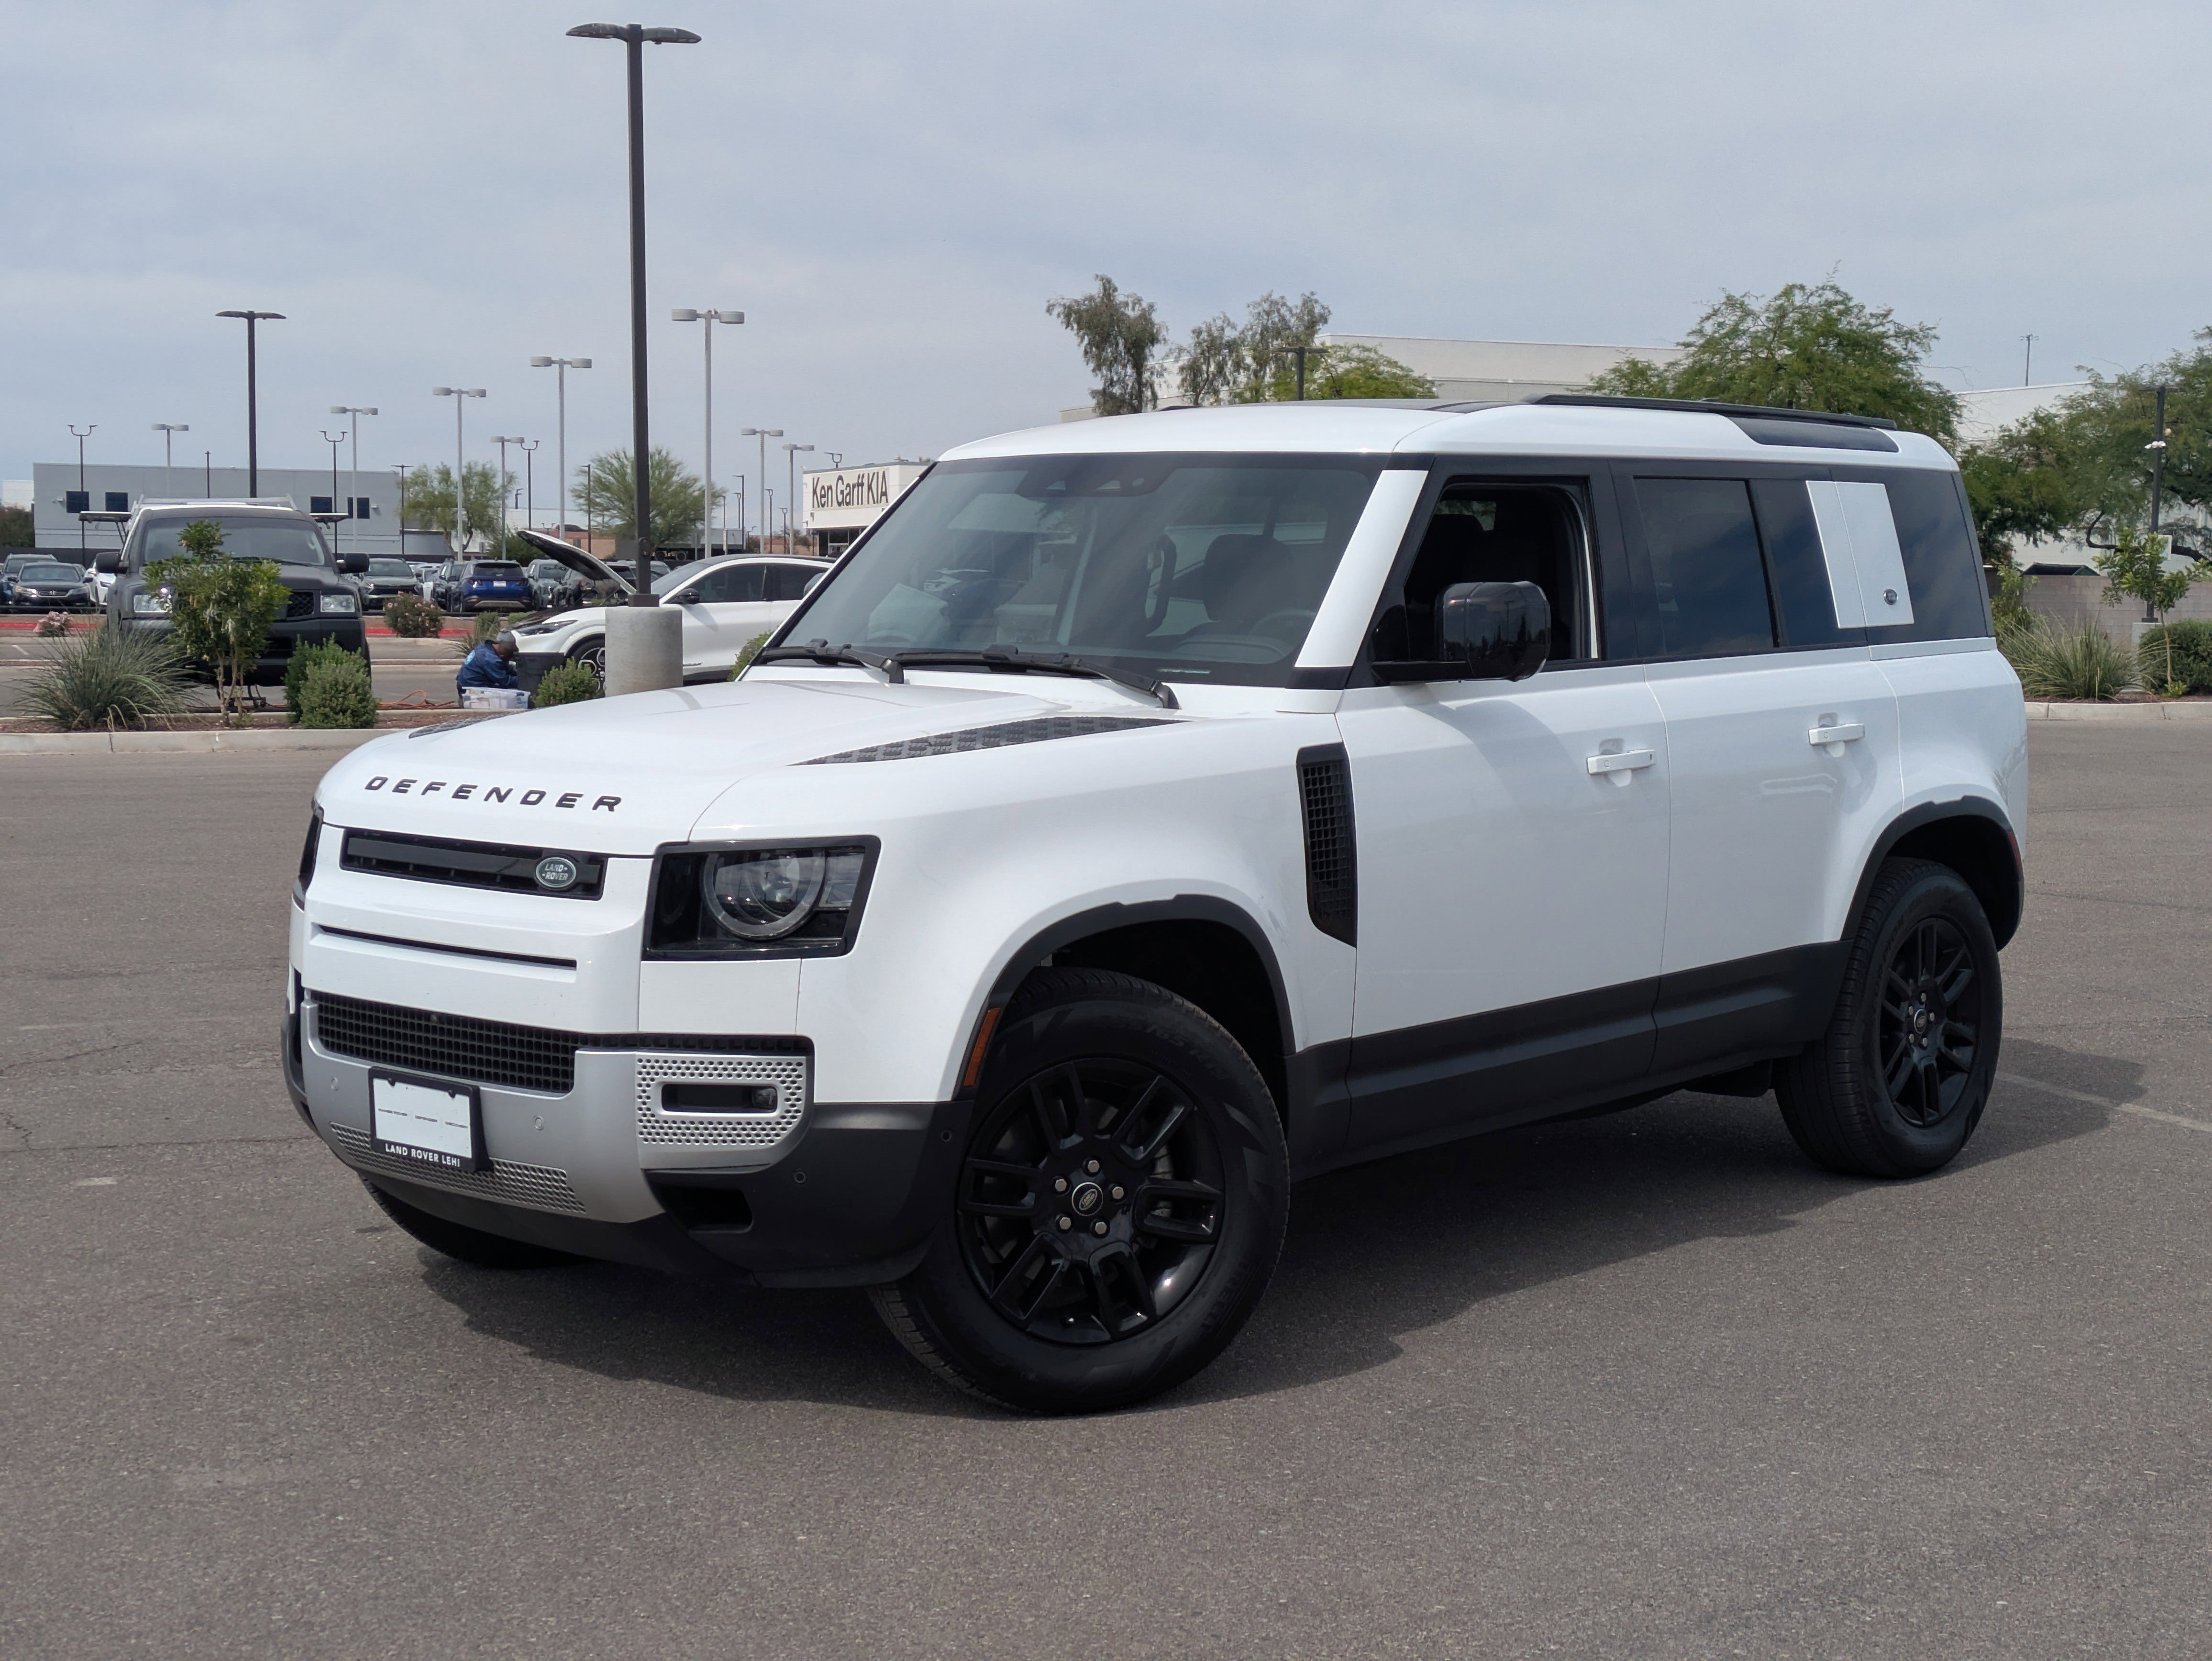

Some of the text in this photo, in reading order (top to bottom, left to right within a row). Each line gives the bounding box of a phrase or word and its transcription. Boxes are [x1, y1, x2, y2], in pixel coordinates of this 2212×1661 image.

[812, 471, 889, 508] Ken Garff KIA
[364, 775, 622, 812] DEFENDER
[385, 1143, 460, 1168] LAND ROVER LEHI
